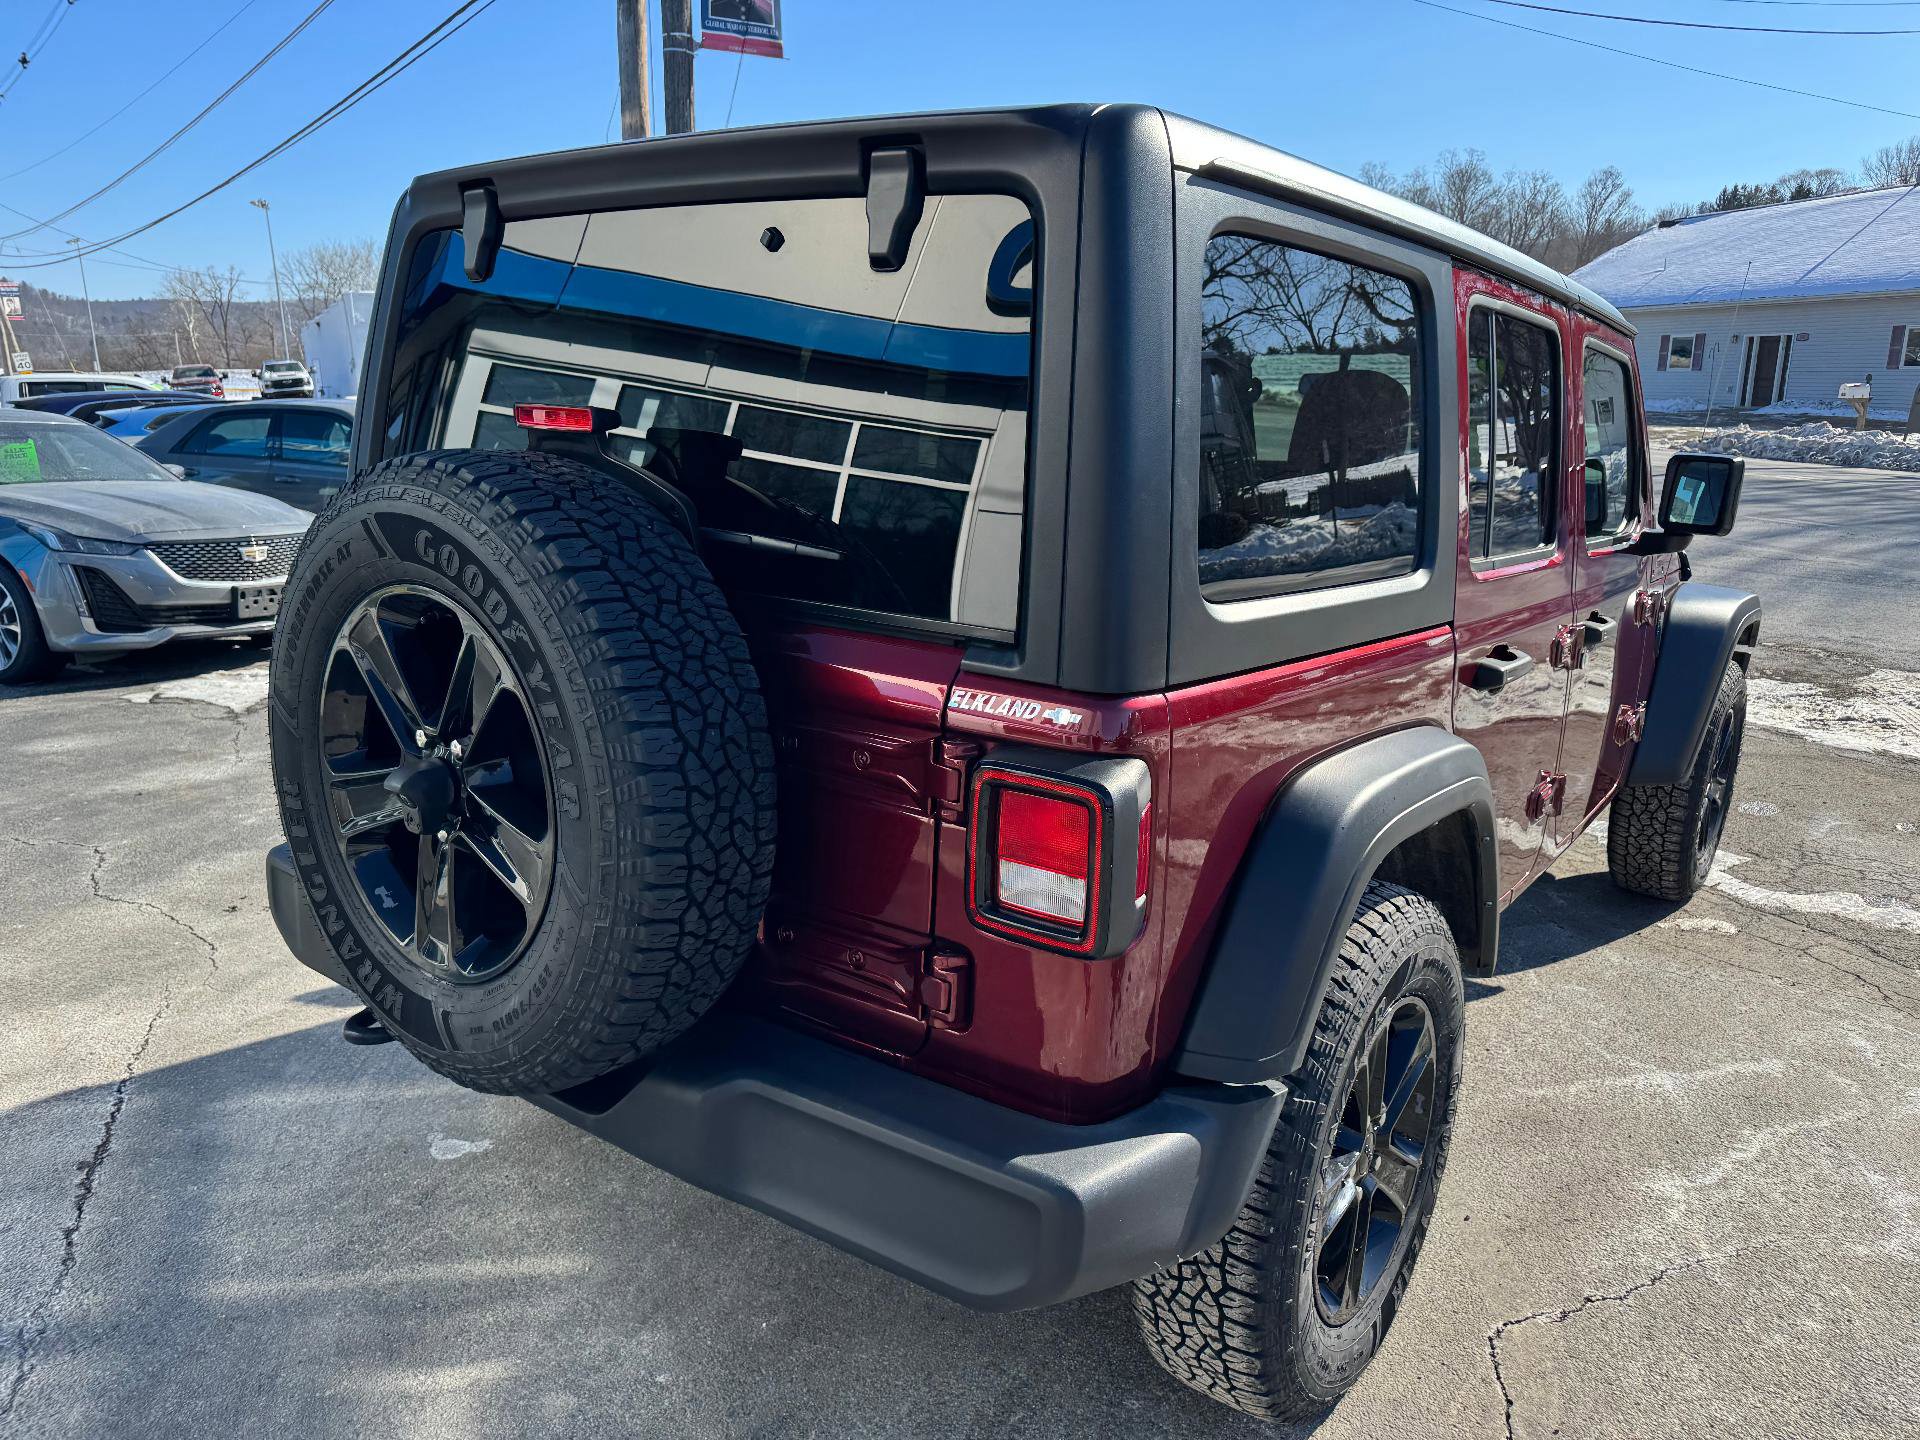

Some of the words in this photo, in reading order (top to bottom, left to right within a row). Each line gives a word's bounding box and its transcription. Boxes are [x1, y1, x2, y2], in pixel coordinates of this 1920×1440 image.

[17, 361, 32, 369] 40
[947, 690, 1041, 720] ELKLAND
[282, 776, 404, 1022] WRANGLER
